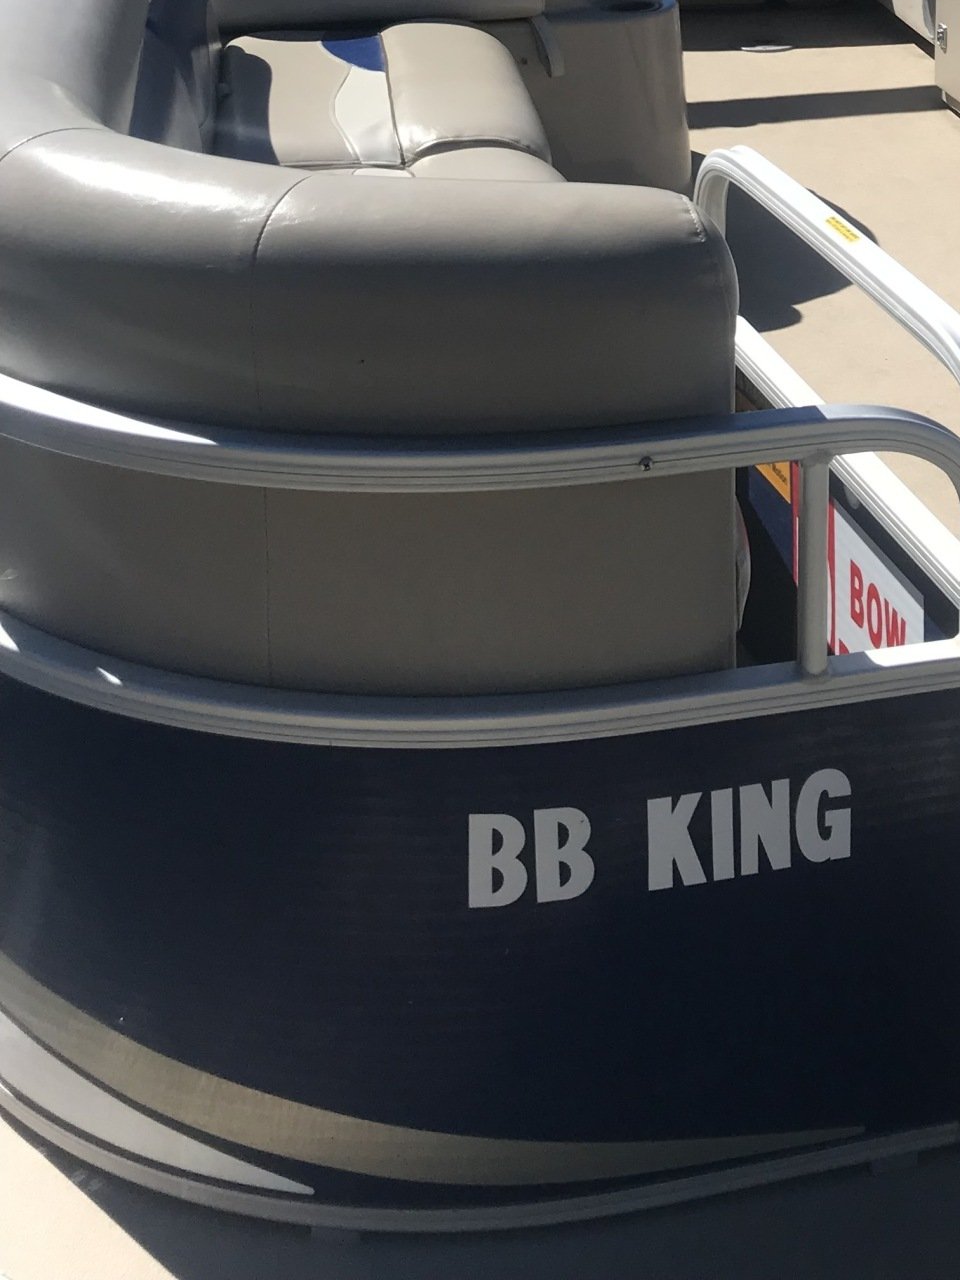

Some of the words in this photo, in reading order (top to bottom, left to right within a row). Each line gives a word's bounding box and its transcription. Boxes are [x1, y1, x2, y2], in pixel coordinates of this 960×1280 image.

[850, 559, 906, 649] BOW
[468, 807, 595, 909] BB
[647, 768, 852, 891] KING
